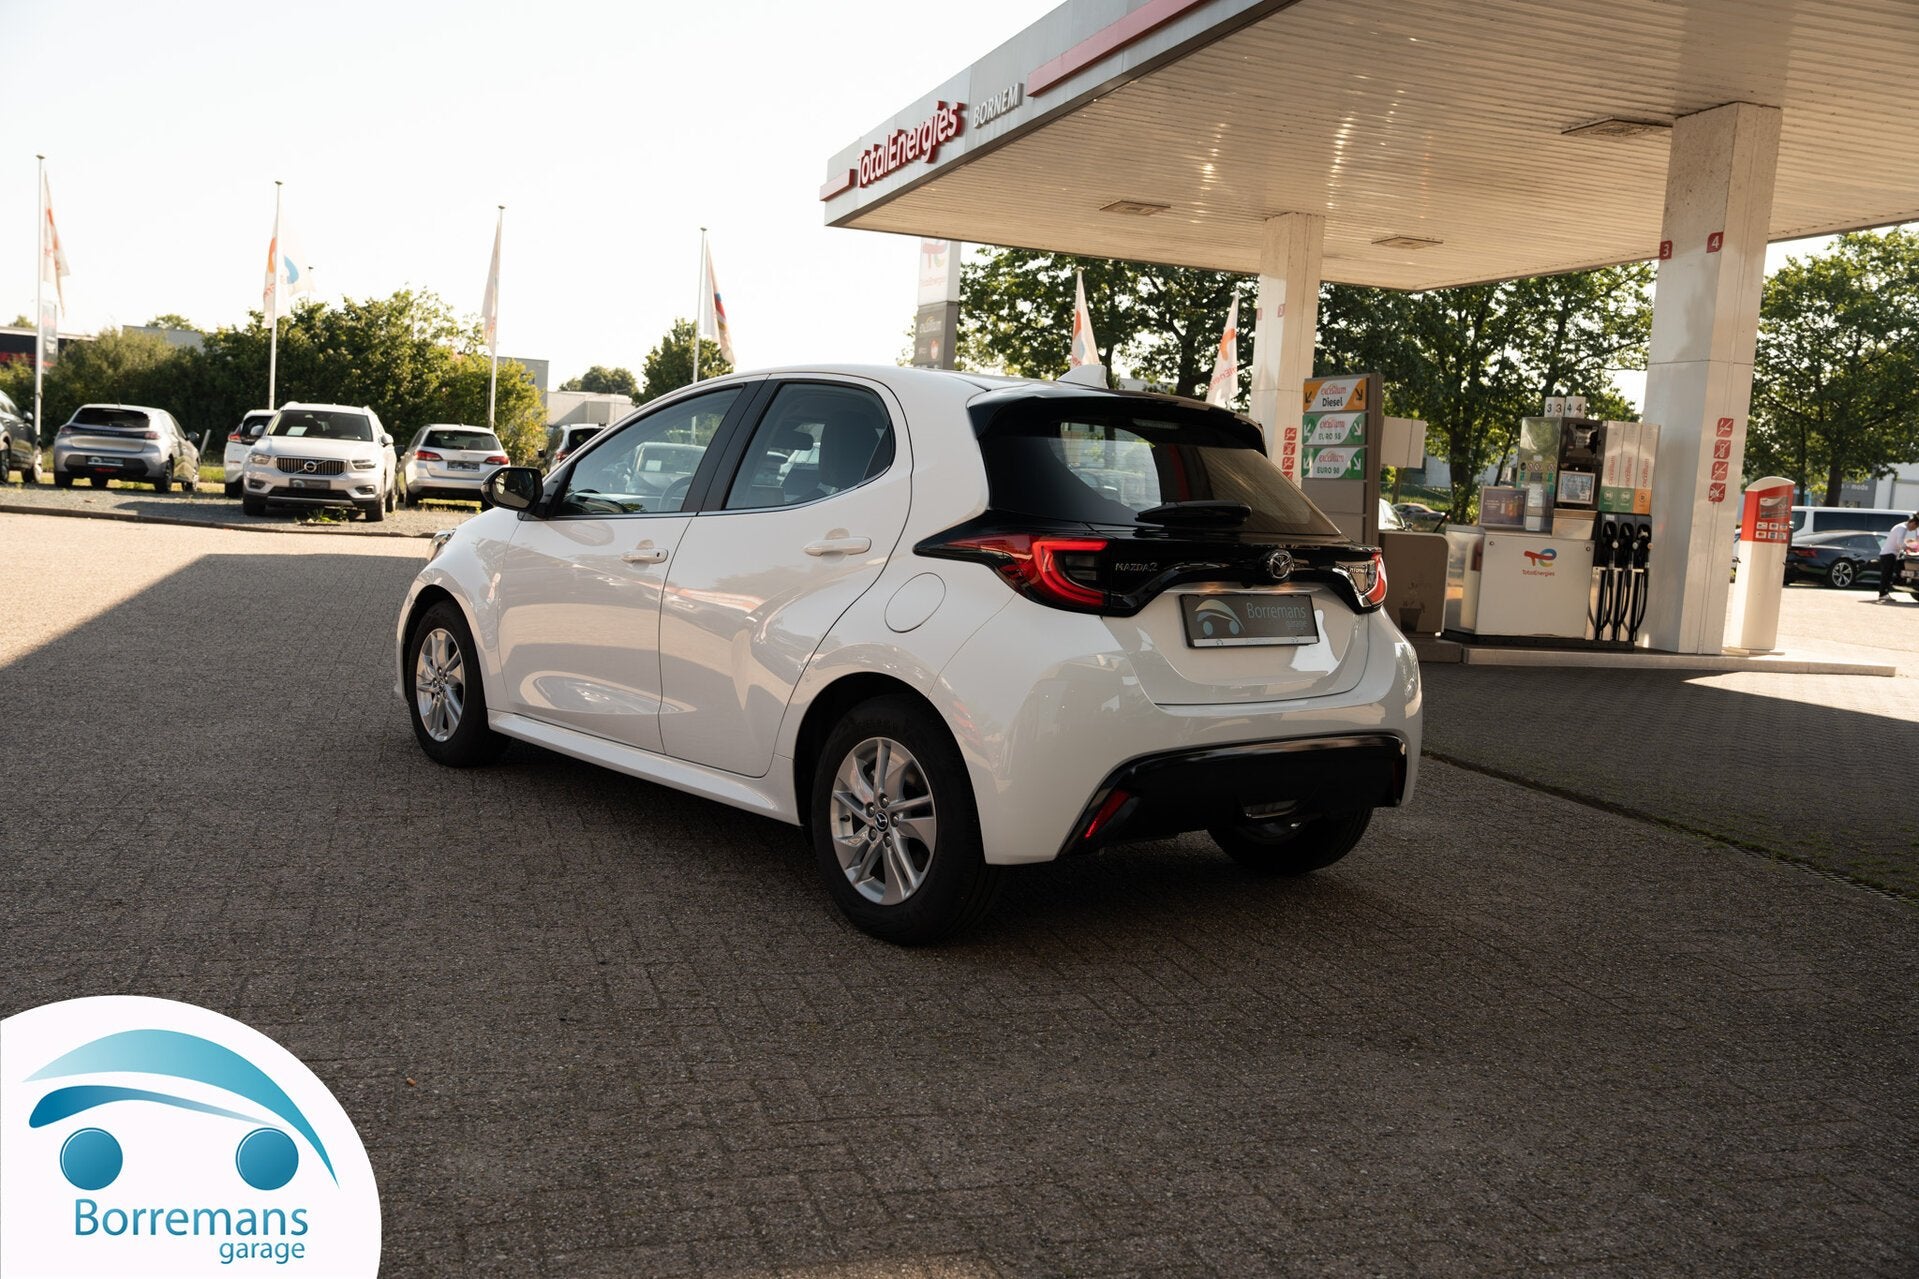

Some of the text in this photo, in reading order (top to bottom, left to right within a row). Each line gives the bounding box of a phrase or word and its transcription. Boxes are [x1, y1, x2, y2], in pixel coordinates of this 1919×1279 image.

[972, 82, 1024, 129] BORNEM
[857, 100, 967, 187] TotalEnergies
[1711, 236, 1720, 249] 4
[1662, 243, 1670, 257] 3
[1322, 397, 1343, 407] Diesel
[1547, 402, 1553, 413] 3
[1556, 402, 1562, 413] 3
[1567, 402, 1572, 413] 4
[1576, 402, 1583, 413] 4
[1318, 432, 1334, 441] EURO
[1316, 466, 1332, 475] EURO
[1246, 602, 1307, 619] Borremans
